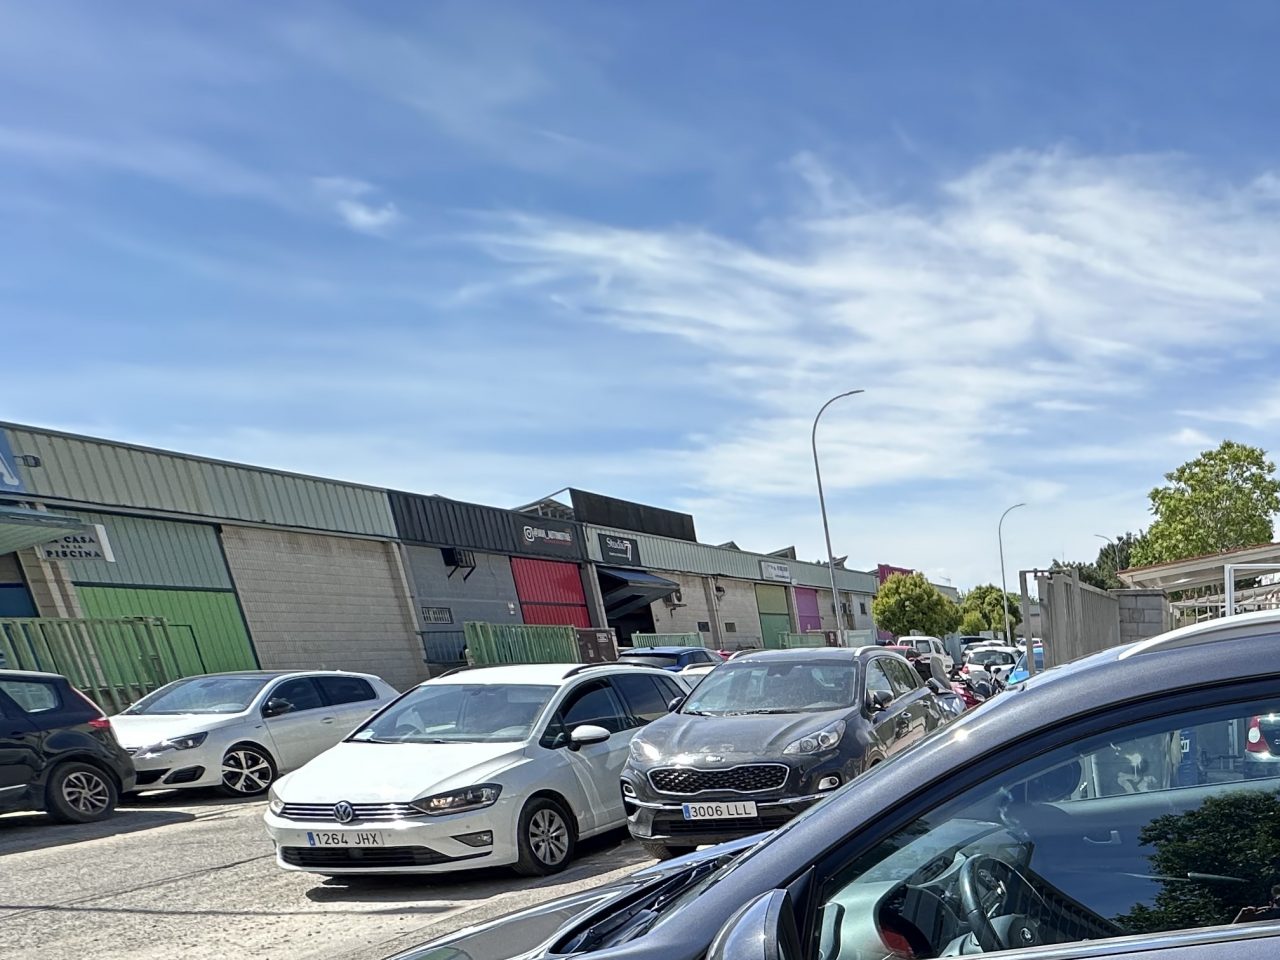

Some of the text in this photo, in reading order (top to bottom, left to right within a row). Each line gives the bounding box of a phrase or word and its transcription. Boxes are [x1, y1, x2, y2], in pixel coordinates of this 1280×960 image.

[64, 536, 95, 544] CASA
[45, 550, 102, 558] PISCINA
[691, 804, 752, 818] 3006 LLL
[315, 832, 379, 845] 1264 JHX
